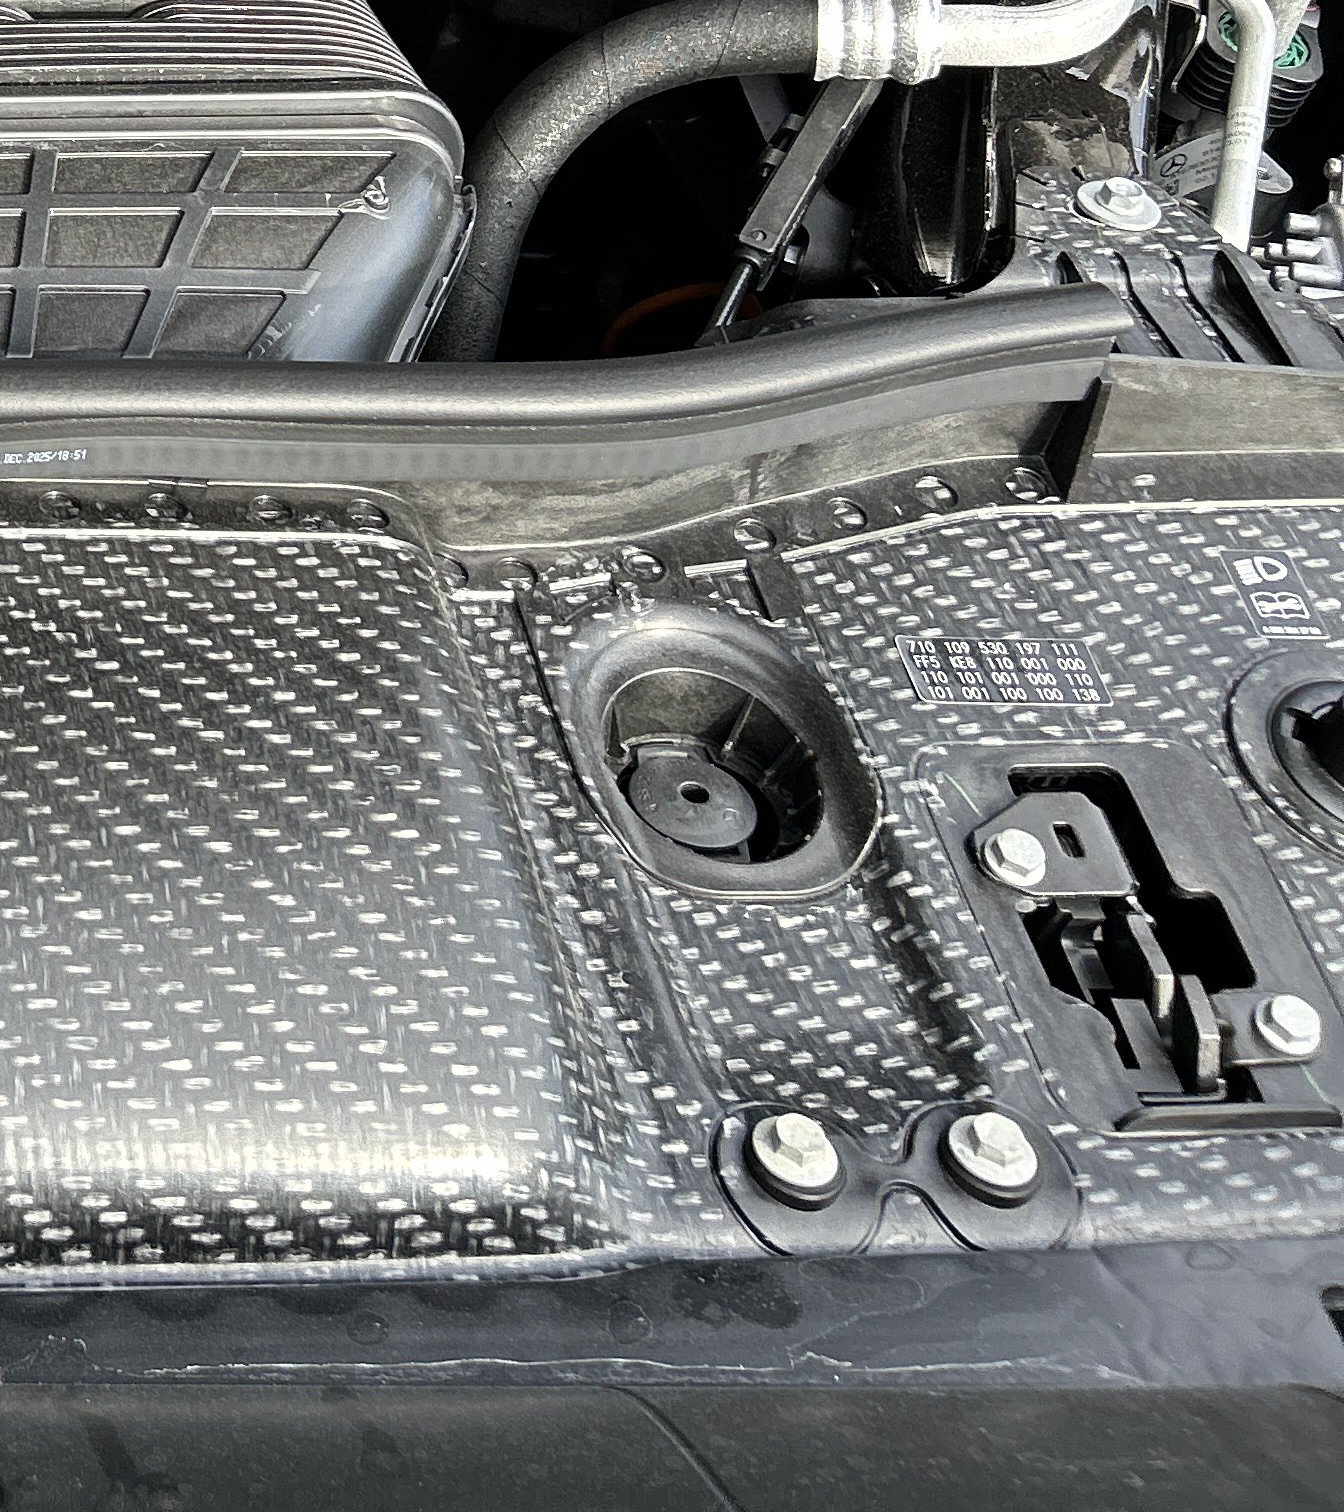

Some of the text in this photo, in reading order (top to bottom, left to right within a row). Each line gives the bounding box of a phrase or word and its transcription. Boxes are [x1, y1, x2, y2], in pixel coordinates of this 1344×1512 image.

[906, 640, 1078, 656] 710 109 530 197 111
[913, 655, 1086, 670] FF5 KE8 110 001 000
[921, 671, 1093, 686] 110 101 001 000 110
[927, 686, 1100, 701] 101 001 100 100 138
